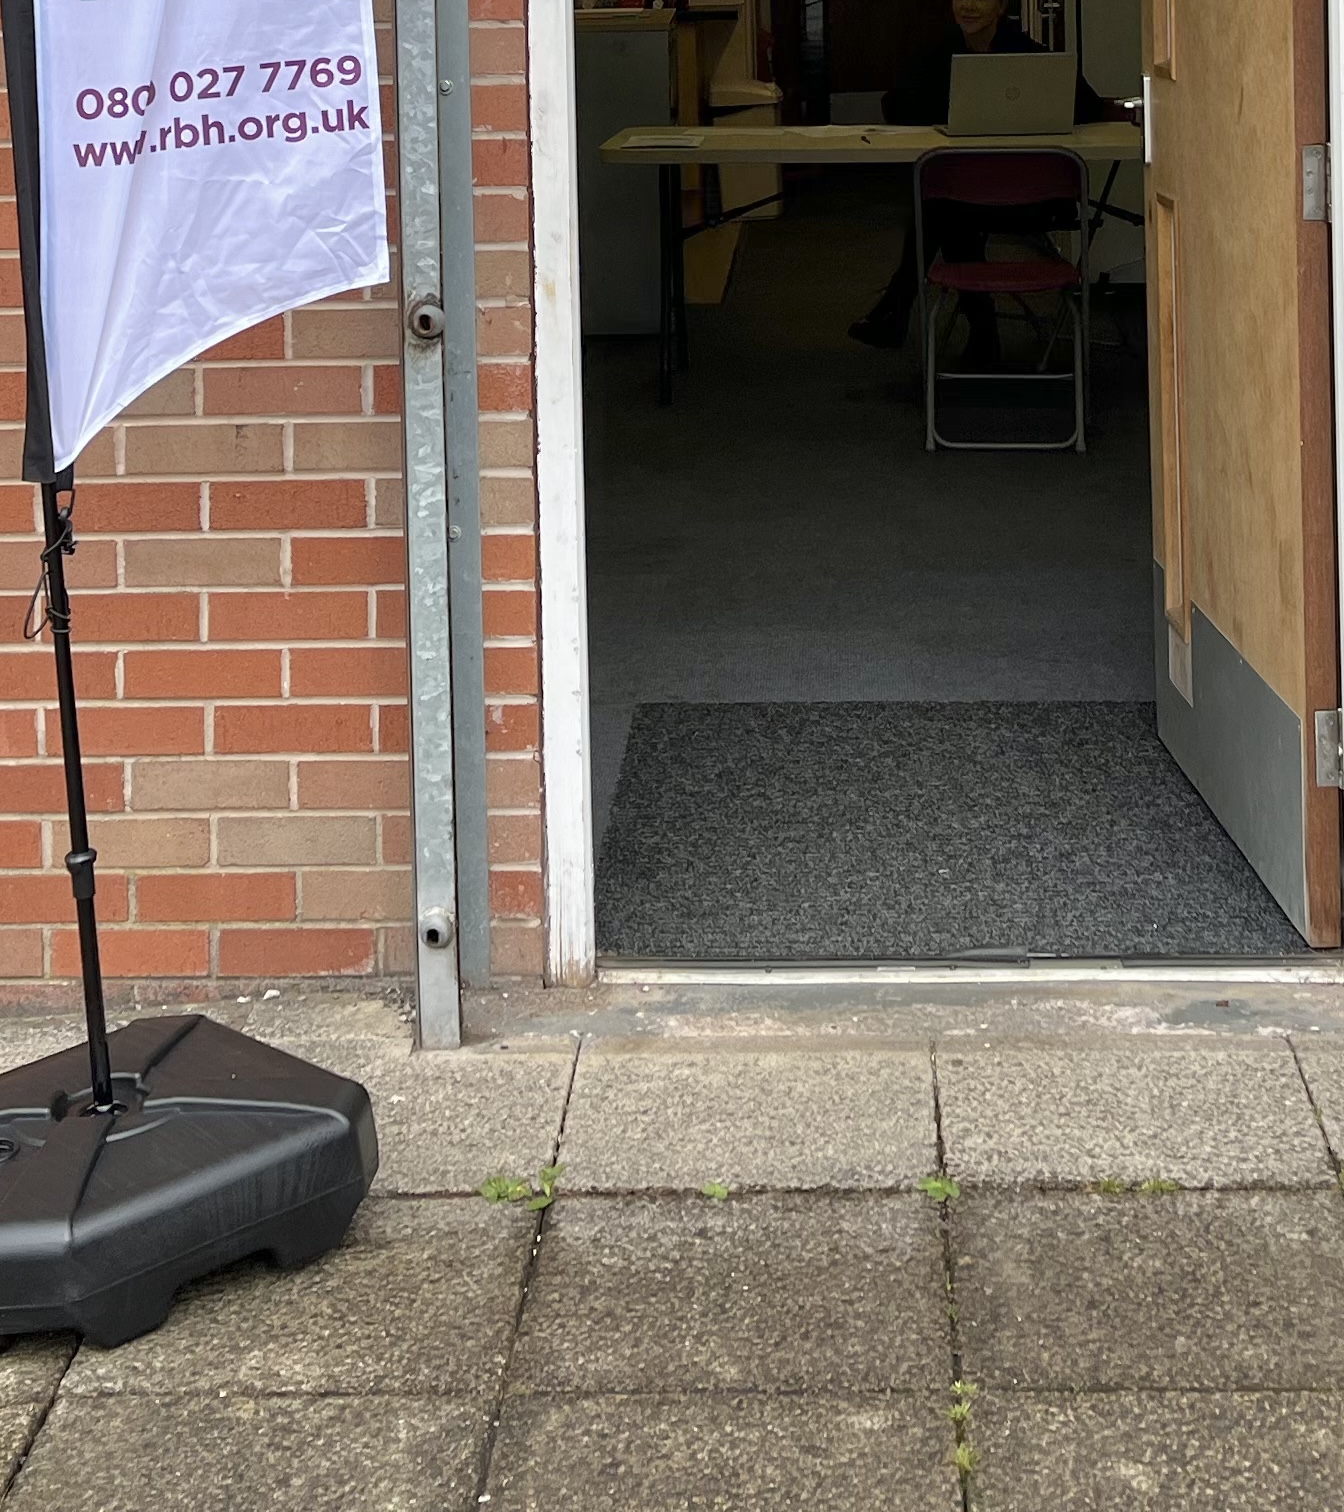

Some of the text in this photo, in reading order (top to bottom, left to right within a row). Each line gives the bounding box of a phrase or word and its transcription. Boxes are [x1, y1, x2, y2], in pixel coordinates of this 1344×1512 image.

[169, 66, 245, 102] 027
[259, 55, 362, 93] 7769
[74, 100, 370, 168] ww.rbh.org.uk
